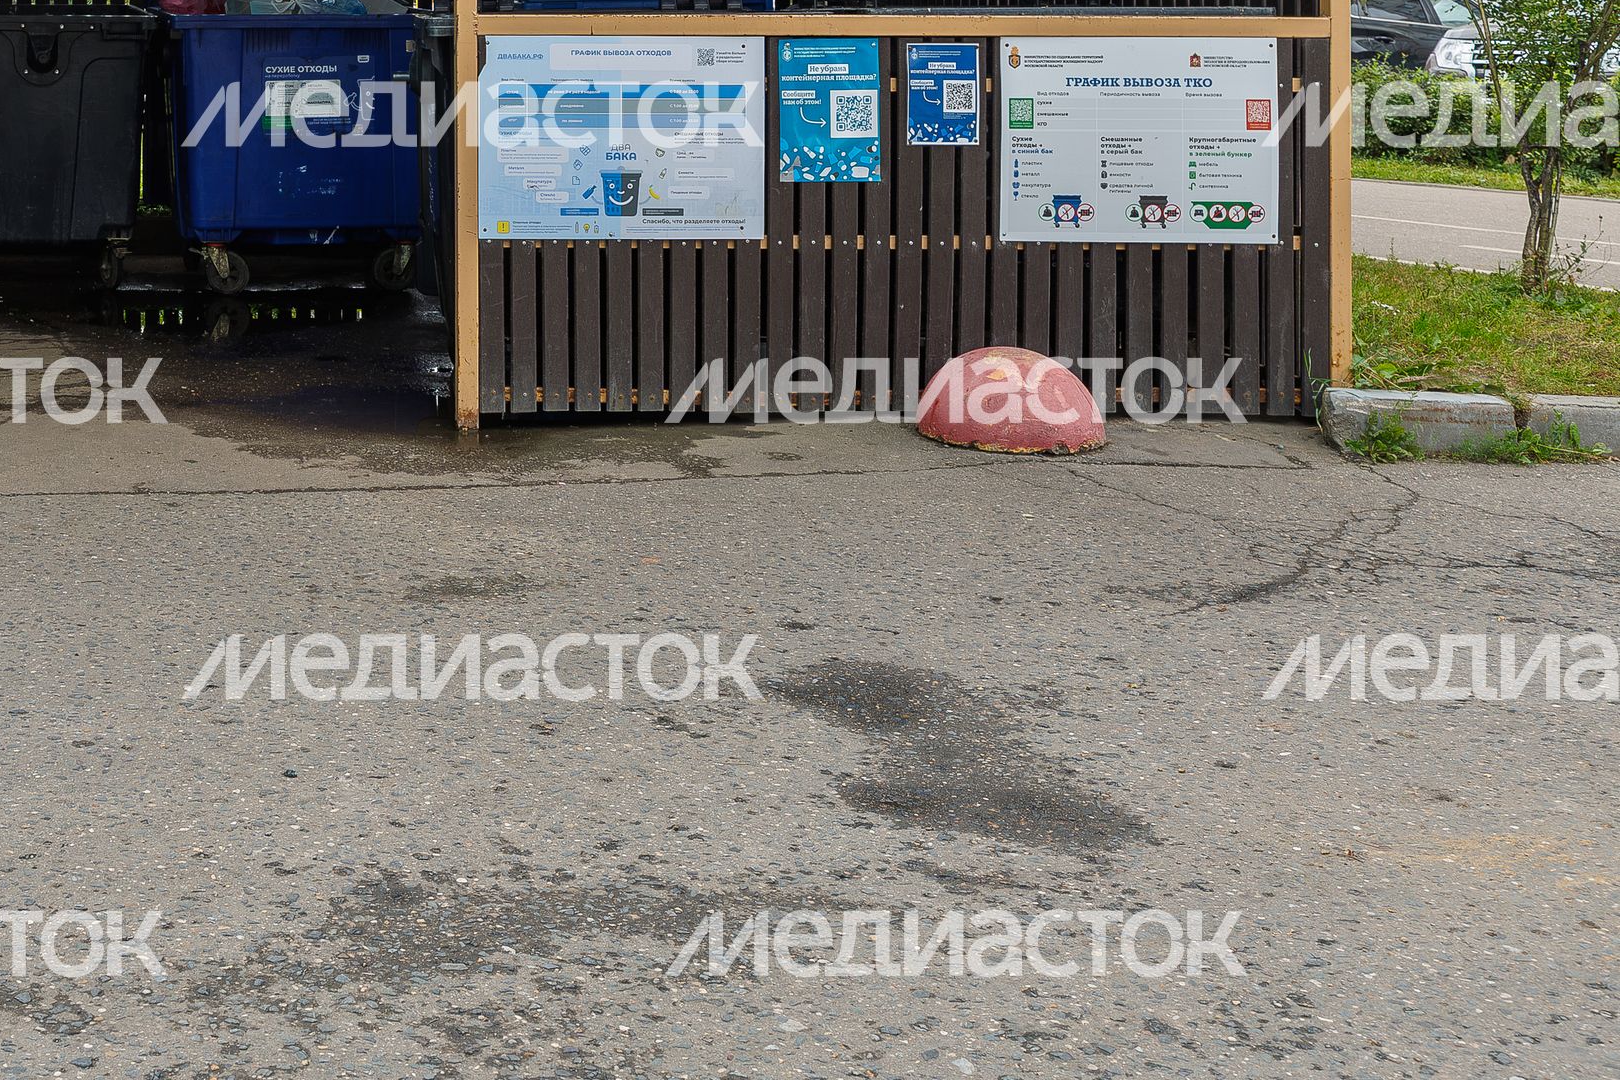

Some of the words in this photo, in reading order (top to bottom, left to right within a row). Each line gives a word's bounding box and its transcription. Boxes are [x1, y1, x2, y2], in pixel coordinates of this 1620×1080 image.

[497, 53, 544, 61] ДВАБАКА.РФ
[570, 49, 601, 57] ГРАФИК
[603, 49, 634, 57] ВЫВОЗА
[636, 49, 672, 57] ОТХОДОВ
[297, 65, 337, 74] ОТХОДЫ
[820, 64, 847, 74] убрана
[781, 73, 835, 83] контейнерная
[836, 74, 877, 82] площадка?
[1066, 77, 1120, 88] ГРАФИК
[1123, 77, 1181, 88] ВЫВОЗА
[1184, 78, 1213, 88] ТКО
[611, 144, 631, 152] ДВА
[605, 152, 637, 161] БАКА
